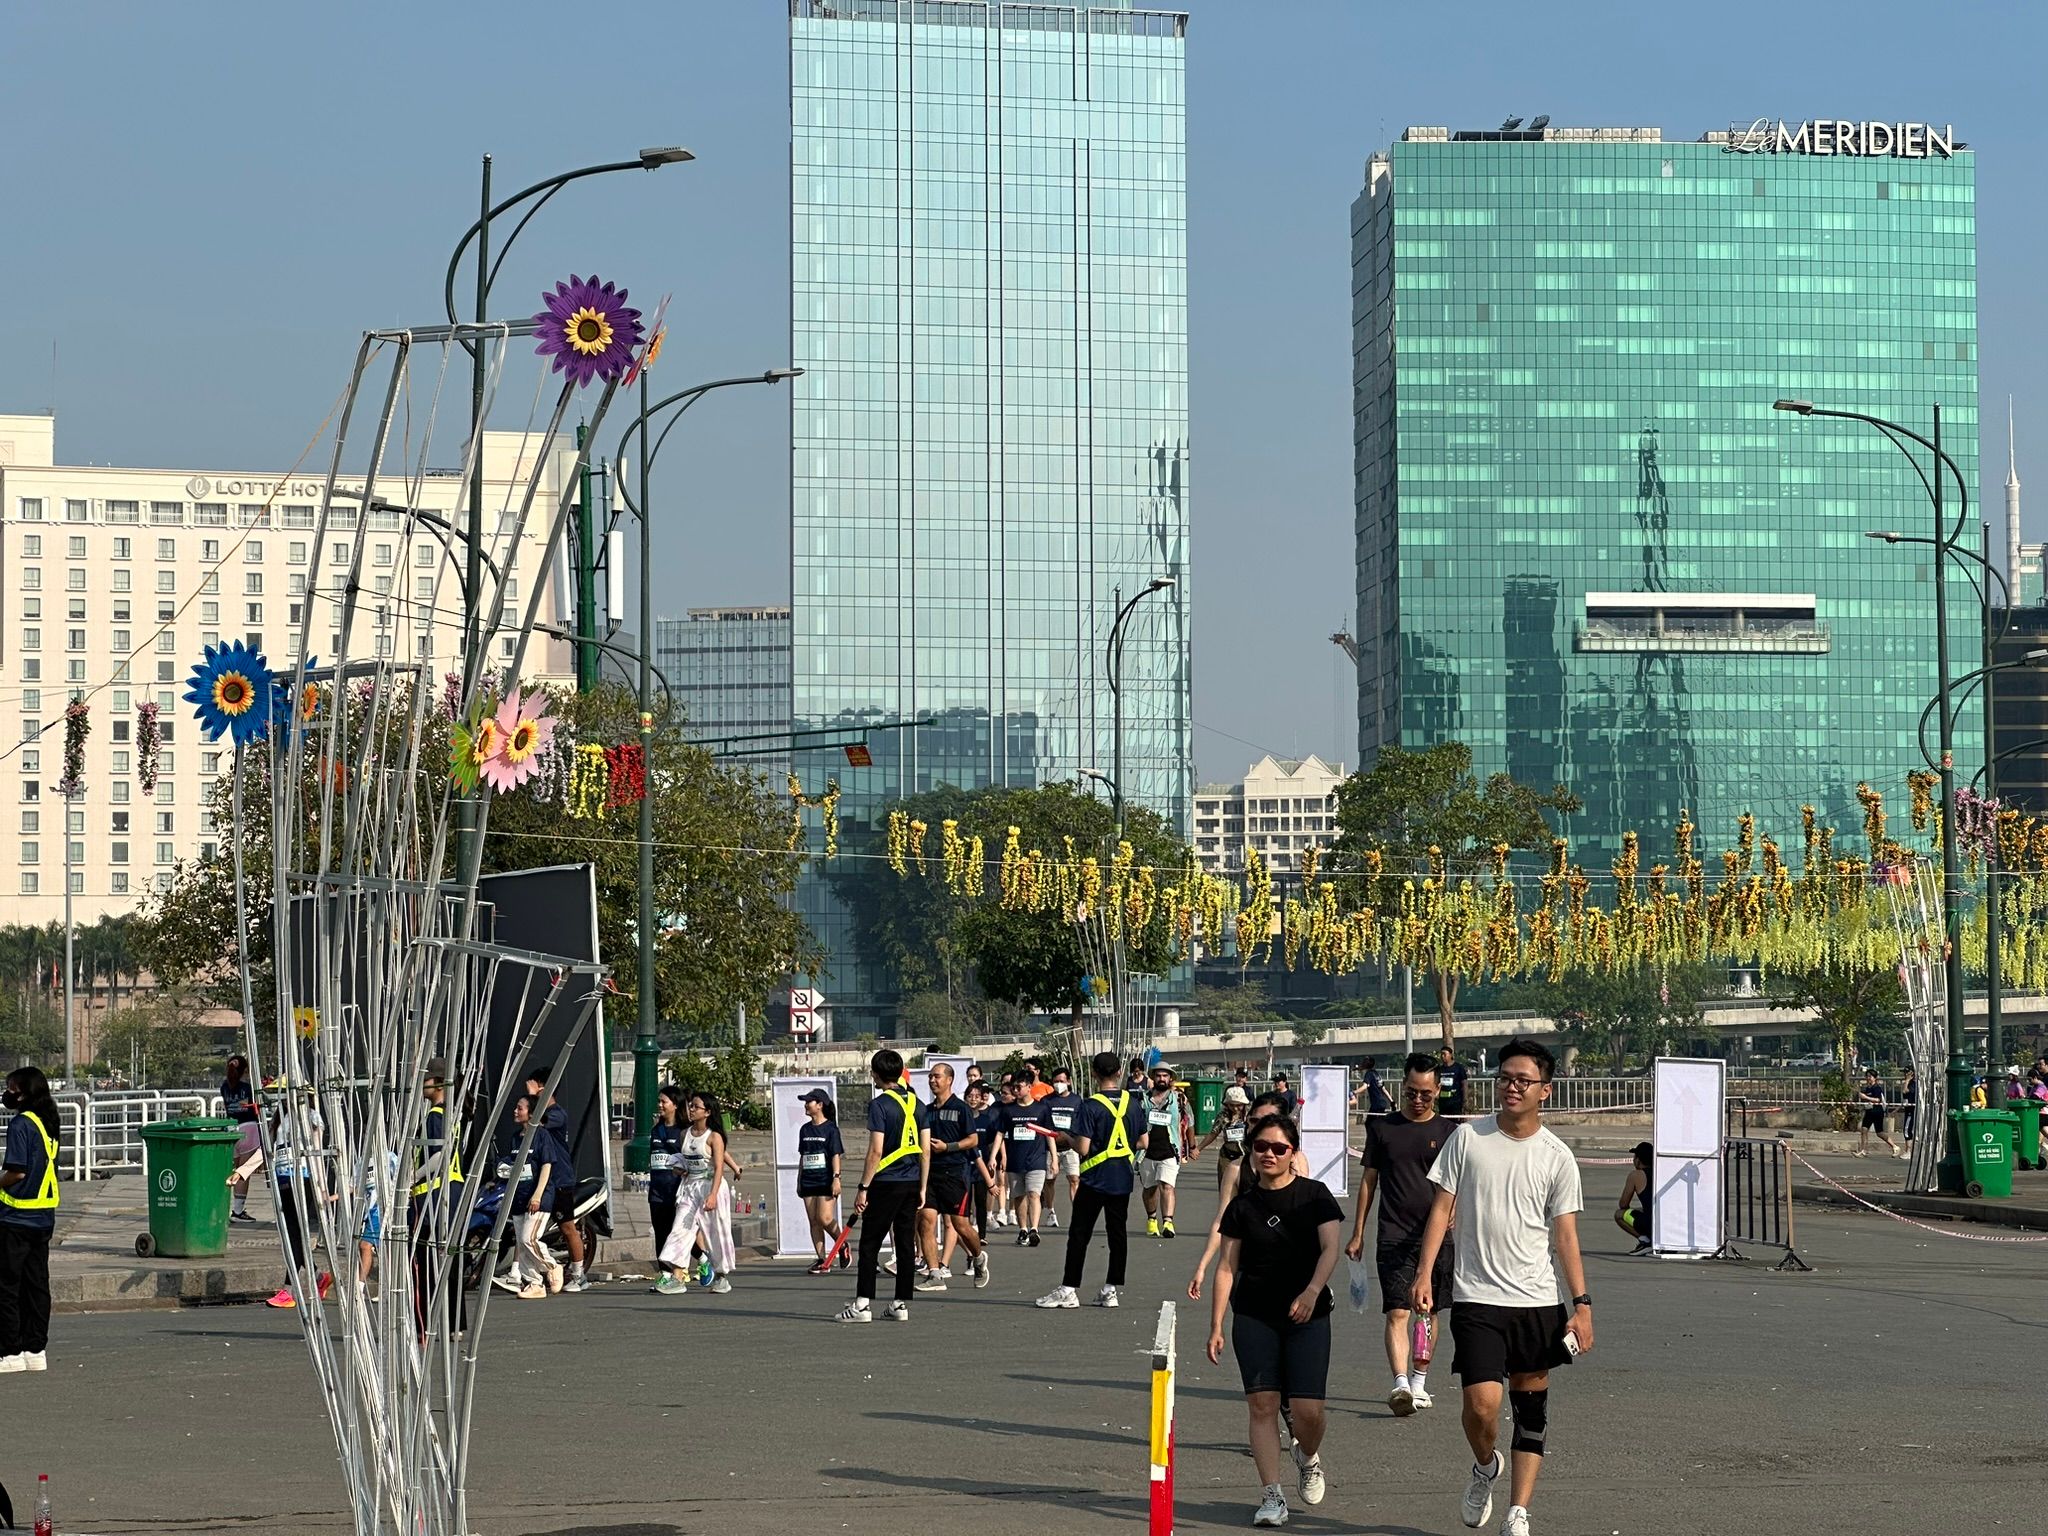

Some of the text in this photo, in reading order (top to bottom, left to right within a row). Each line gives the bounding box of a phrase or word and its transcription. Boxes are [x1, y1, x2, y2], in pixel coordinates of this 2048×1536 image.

[1726, 117, 1953, 158] Le MERIDIEN
[216, 480, 287, 496] LOTTE
